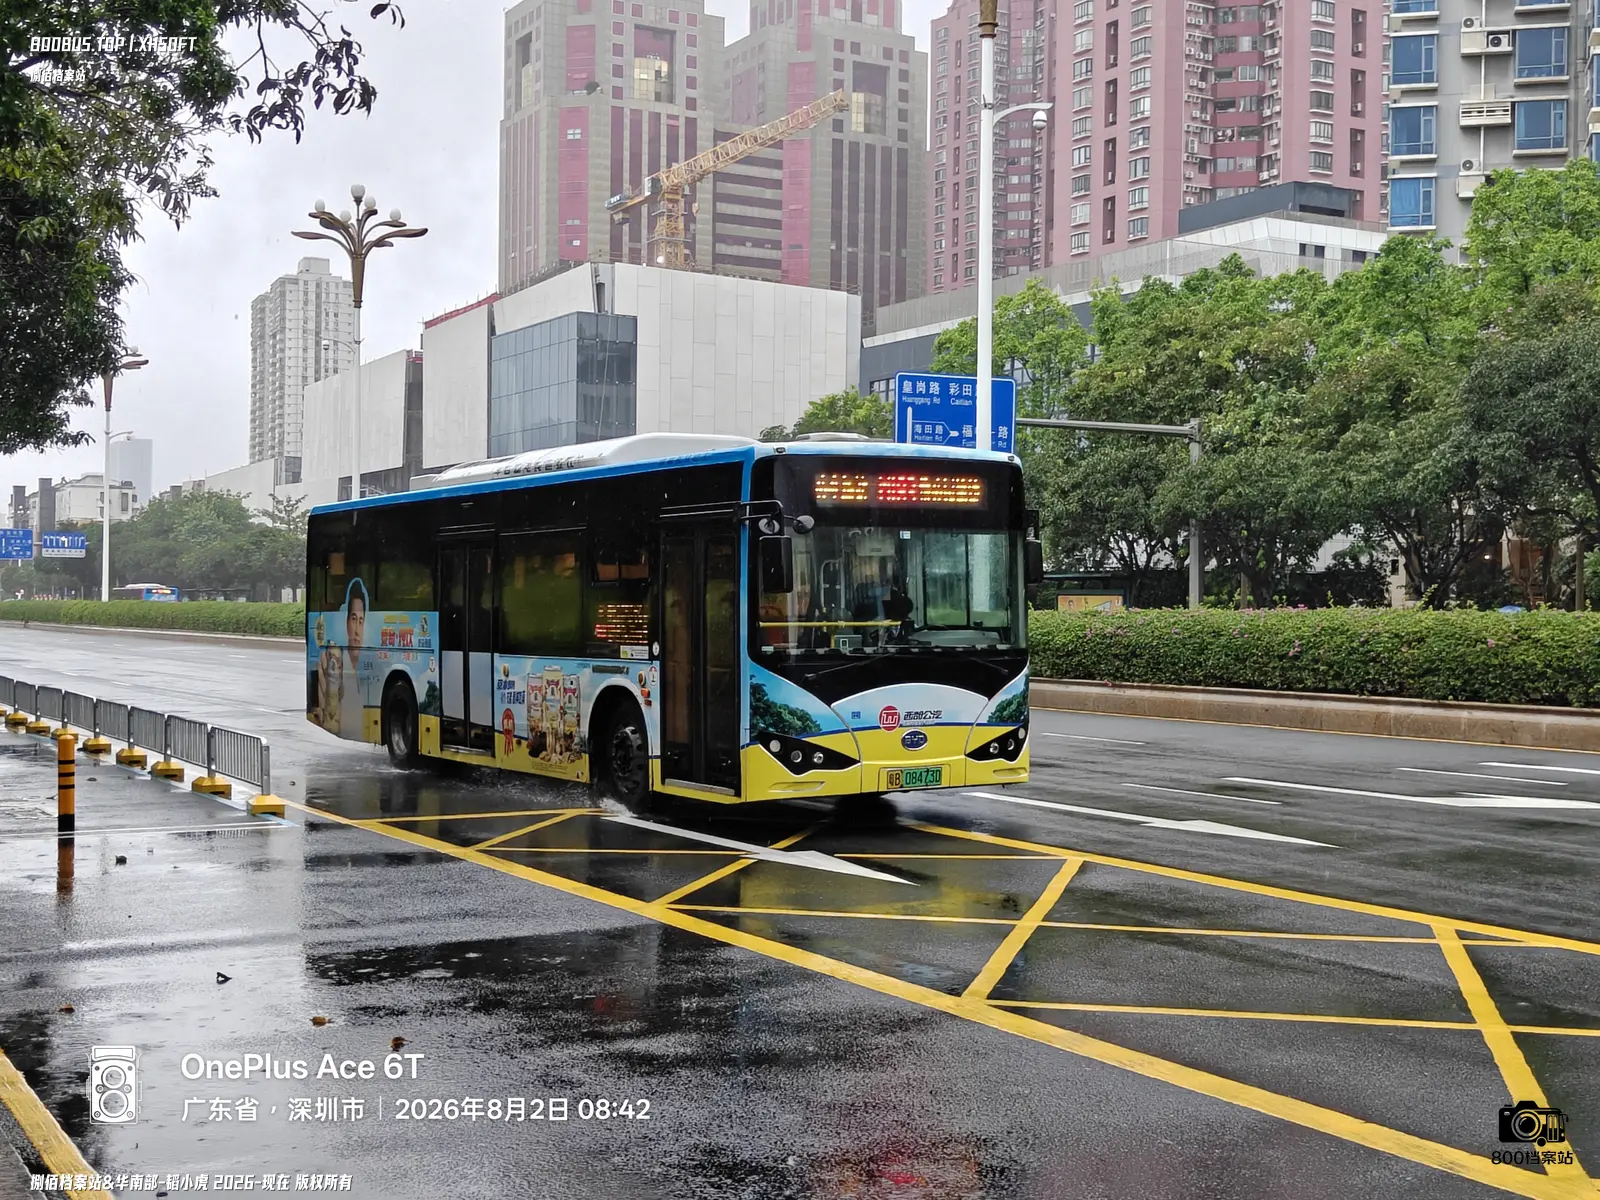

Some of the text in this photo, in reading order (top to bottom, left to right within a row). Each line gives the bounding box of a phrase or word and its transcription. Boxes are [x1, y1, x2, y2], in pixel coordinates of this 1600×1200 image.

[902, 380, 978, 397] 皇岗路 彩田
[905, 735, 925, 744] BYD
